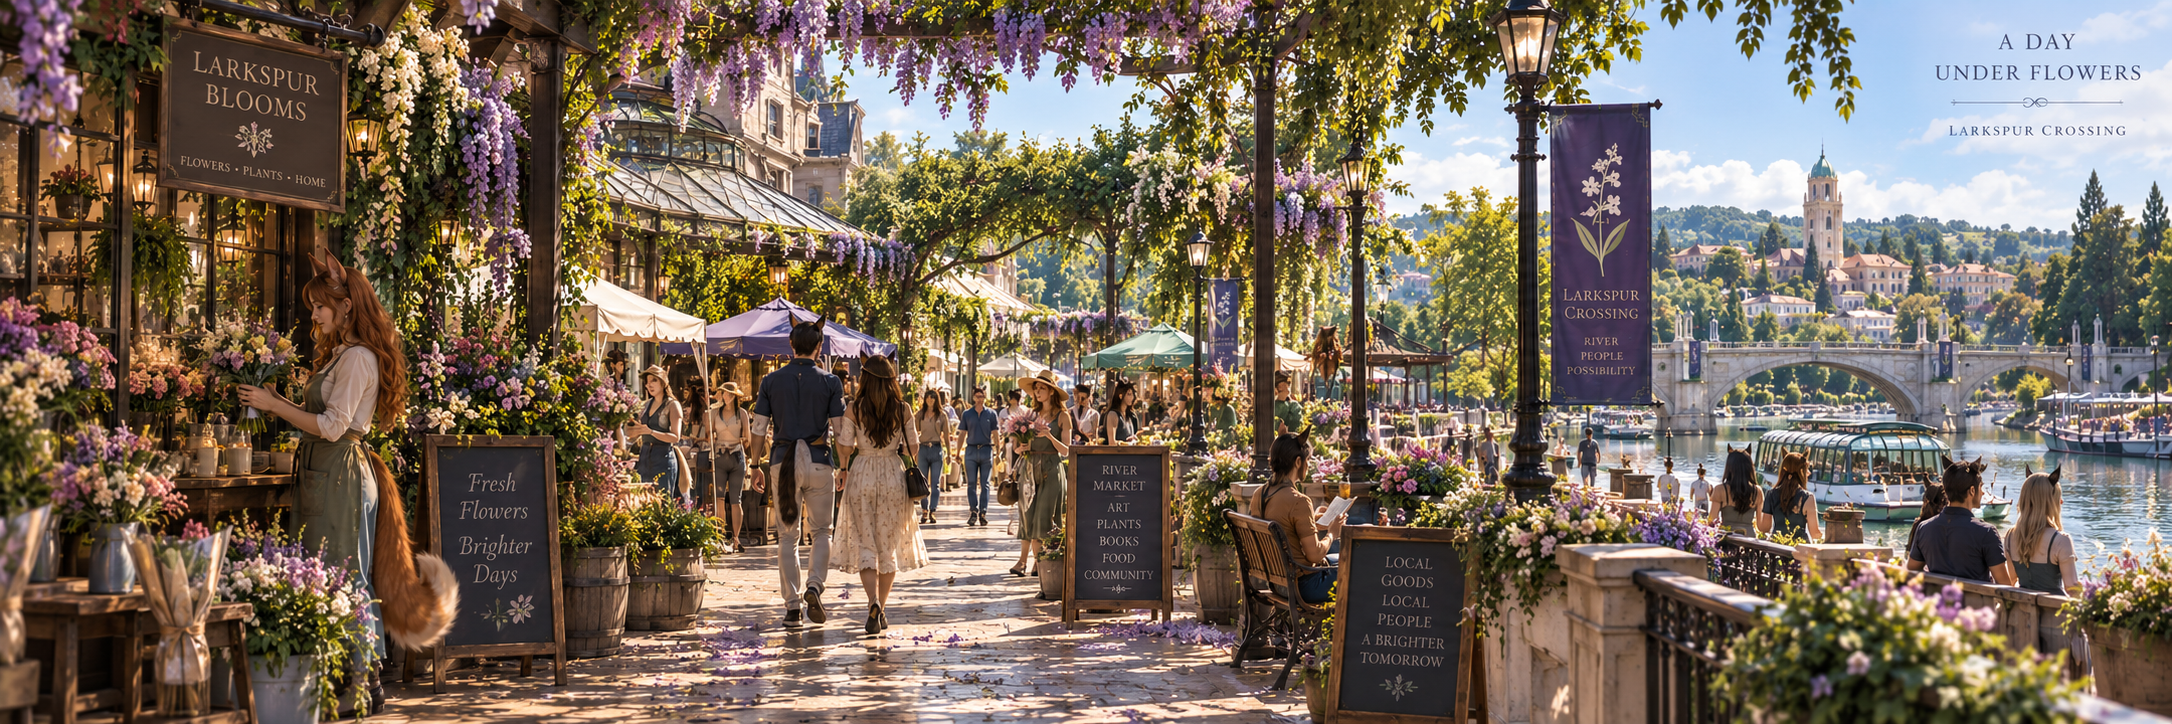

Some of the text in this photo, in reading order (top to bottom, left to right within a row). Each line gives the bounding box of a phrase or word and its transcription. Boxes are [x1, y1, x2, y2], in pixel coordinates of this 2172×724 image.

[193, 50, 320, 96] LARKSPUR
[205, 83, 307, 122] BLOOMS
[180, 155, 326, 188] FLOWERS PLANTS HOME
[1584, 337, 1619, 346] RIVER
[1581, 351, 1624, 361] PEOPLE
[1567, 366, 1636, 375] POSSIBILITY
[1102, 465, 1138, 475] RIVER
[468, 472, 517, 492] Fresh
[1093, 480, 1146, 491] MARKET
[459, 500, 529, 520] Flowers
[1107, 502, 1130, 512] ART
[1097, 519, 1141, 529] PLANTS
[459, 534, 533, 561] Brighter
[1099, 536, 1139, 546] BOOKS
[1102, 553, 1136, 563] FOOD
[1385, 556, 1433, 570] LOCAL
[473, 563, 518, 590] Days
[1084, 569, 1154, 580] COMMUNITY
[1381, 574, 1434, 589] GOODS
[1382, 594, 1430, 608] LOCAL
[1377, 612, 1432, 628] PEOPLE
[1361, 633, 1445, 649] A BRIGHTER
[1360, 651, 1444, 667] TOMORROW
